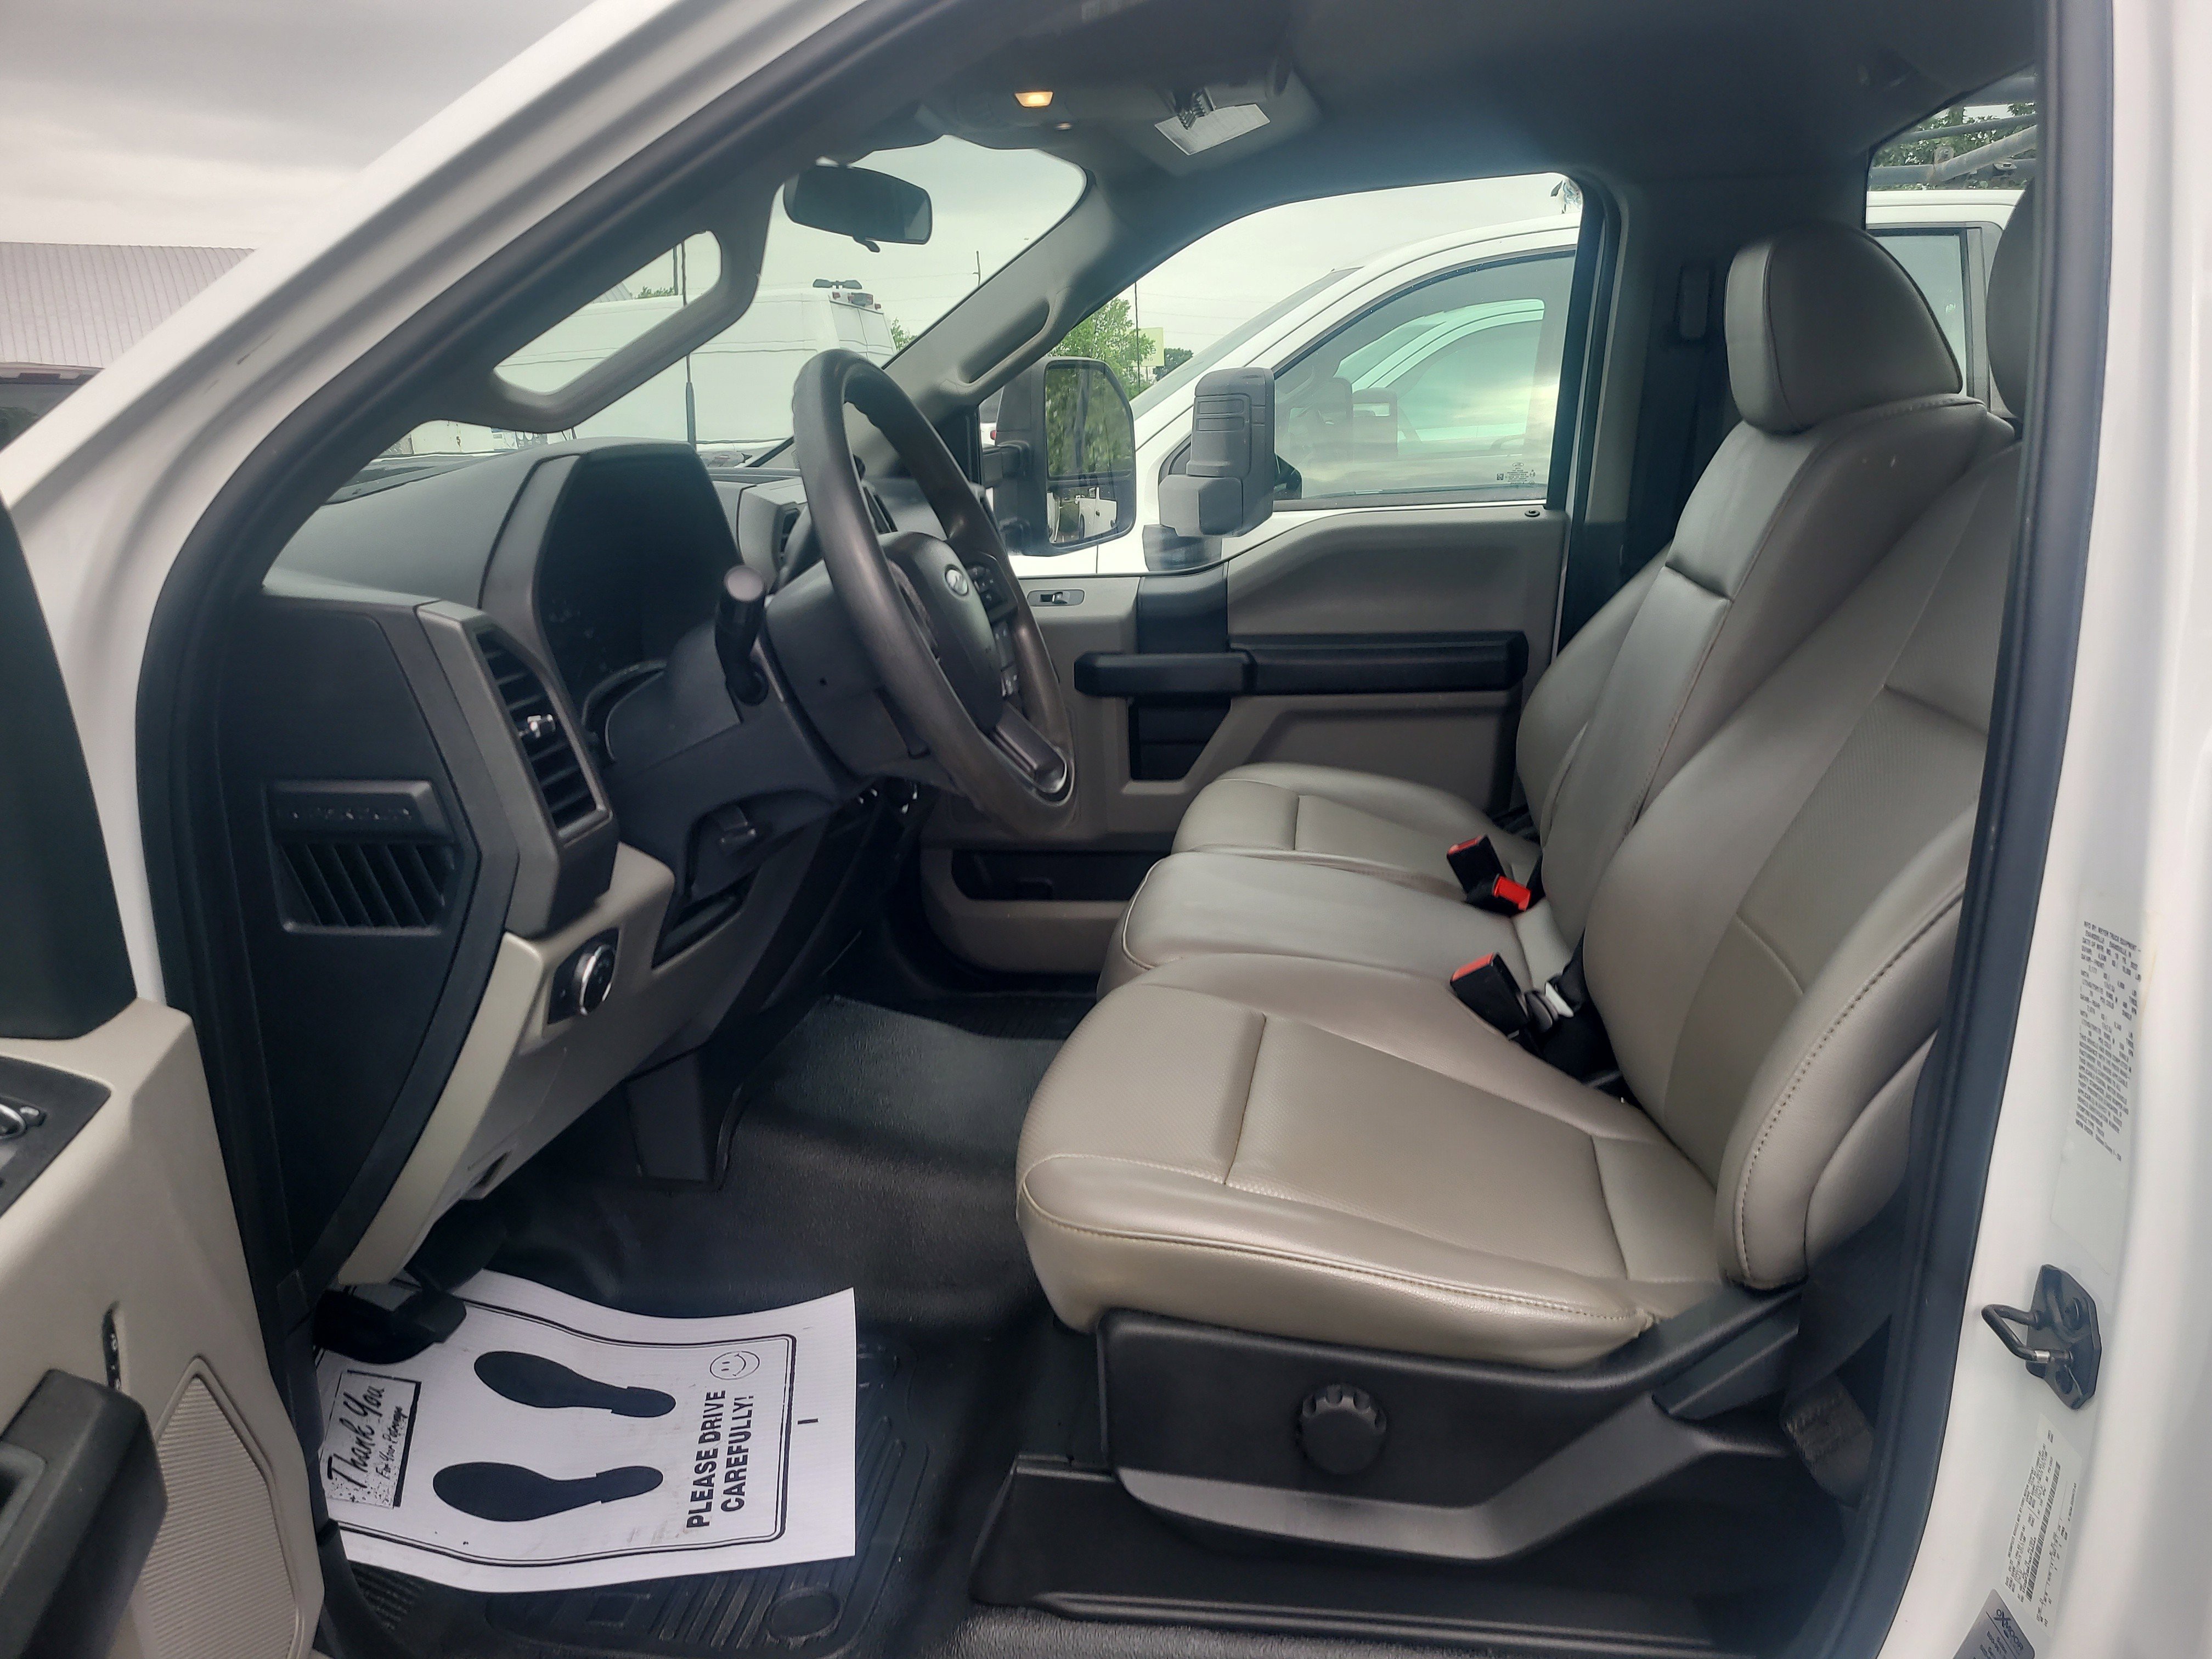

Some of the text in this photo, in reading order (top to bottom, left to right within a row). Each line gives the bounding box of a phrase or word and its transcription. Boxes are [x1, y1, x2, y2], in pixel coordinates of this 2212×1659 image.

[328, 1385, 385, 1488] Thank You
[686, 1390, 726, 1528] PLEASE DRIVE
[720, 1396, 754, 1512] CAREFULLY!
